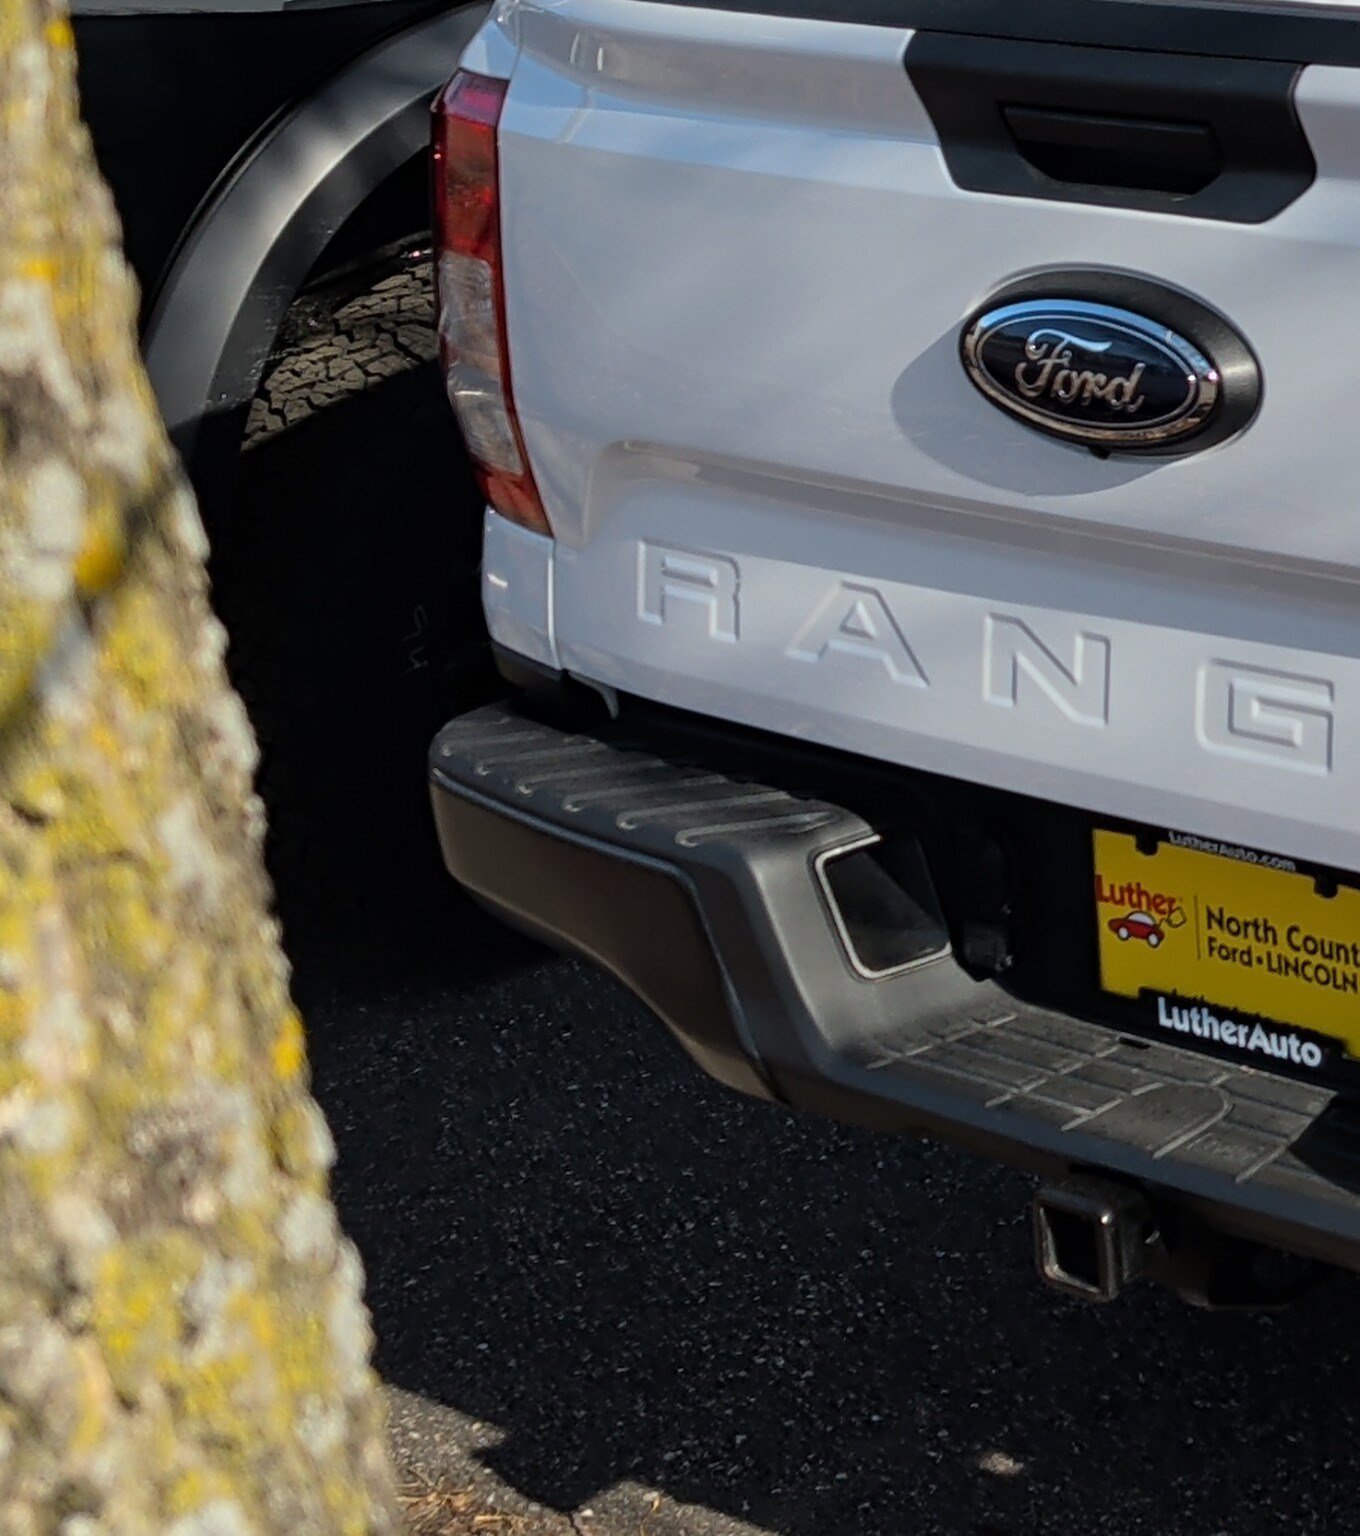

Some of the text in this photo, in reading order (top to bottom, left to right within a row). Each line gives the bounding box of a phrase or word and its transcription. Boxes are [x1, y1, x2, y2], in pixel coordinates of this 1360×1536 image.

[1015, 328, 1145, 413] Ford
[1168, 831, 1296, 872] LutherAuto.com
[1095, 874, 1177, 916] Luther
[1206, 905, 1278, 946] North
[1157, 997, 1323, 1068] LutherAuto
